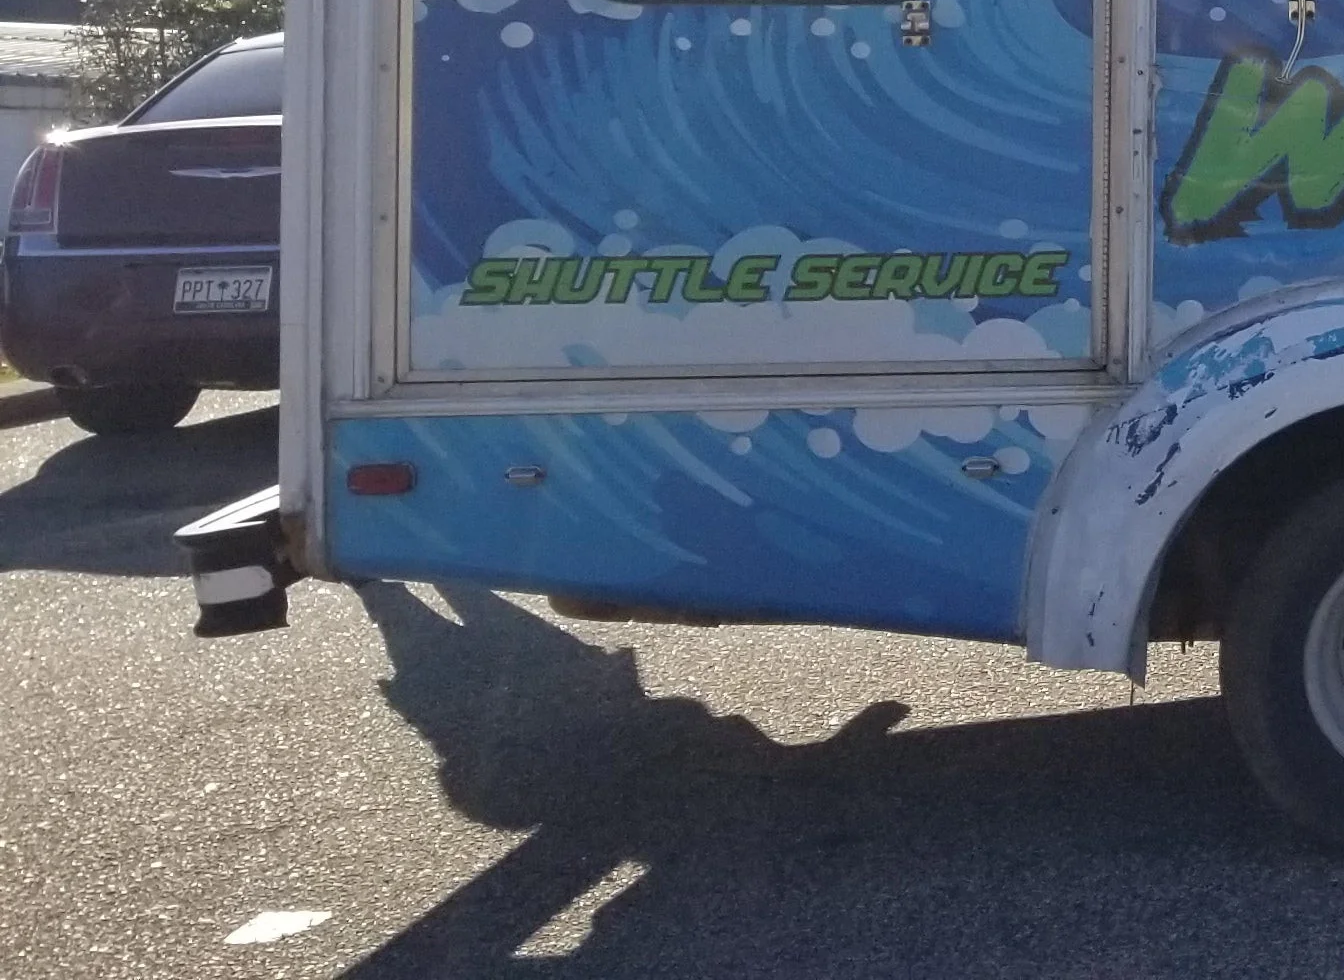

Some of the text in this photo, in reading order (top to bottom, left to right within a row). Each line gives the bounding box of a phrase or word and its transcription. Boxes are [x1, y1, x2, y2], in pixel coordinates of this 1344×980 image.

[181, 279, 264, 301] PPT 327
[461, 250, 1069, 305] SHUTTLE SERVICE
